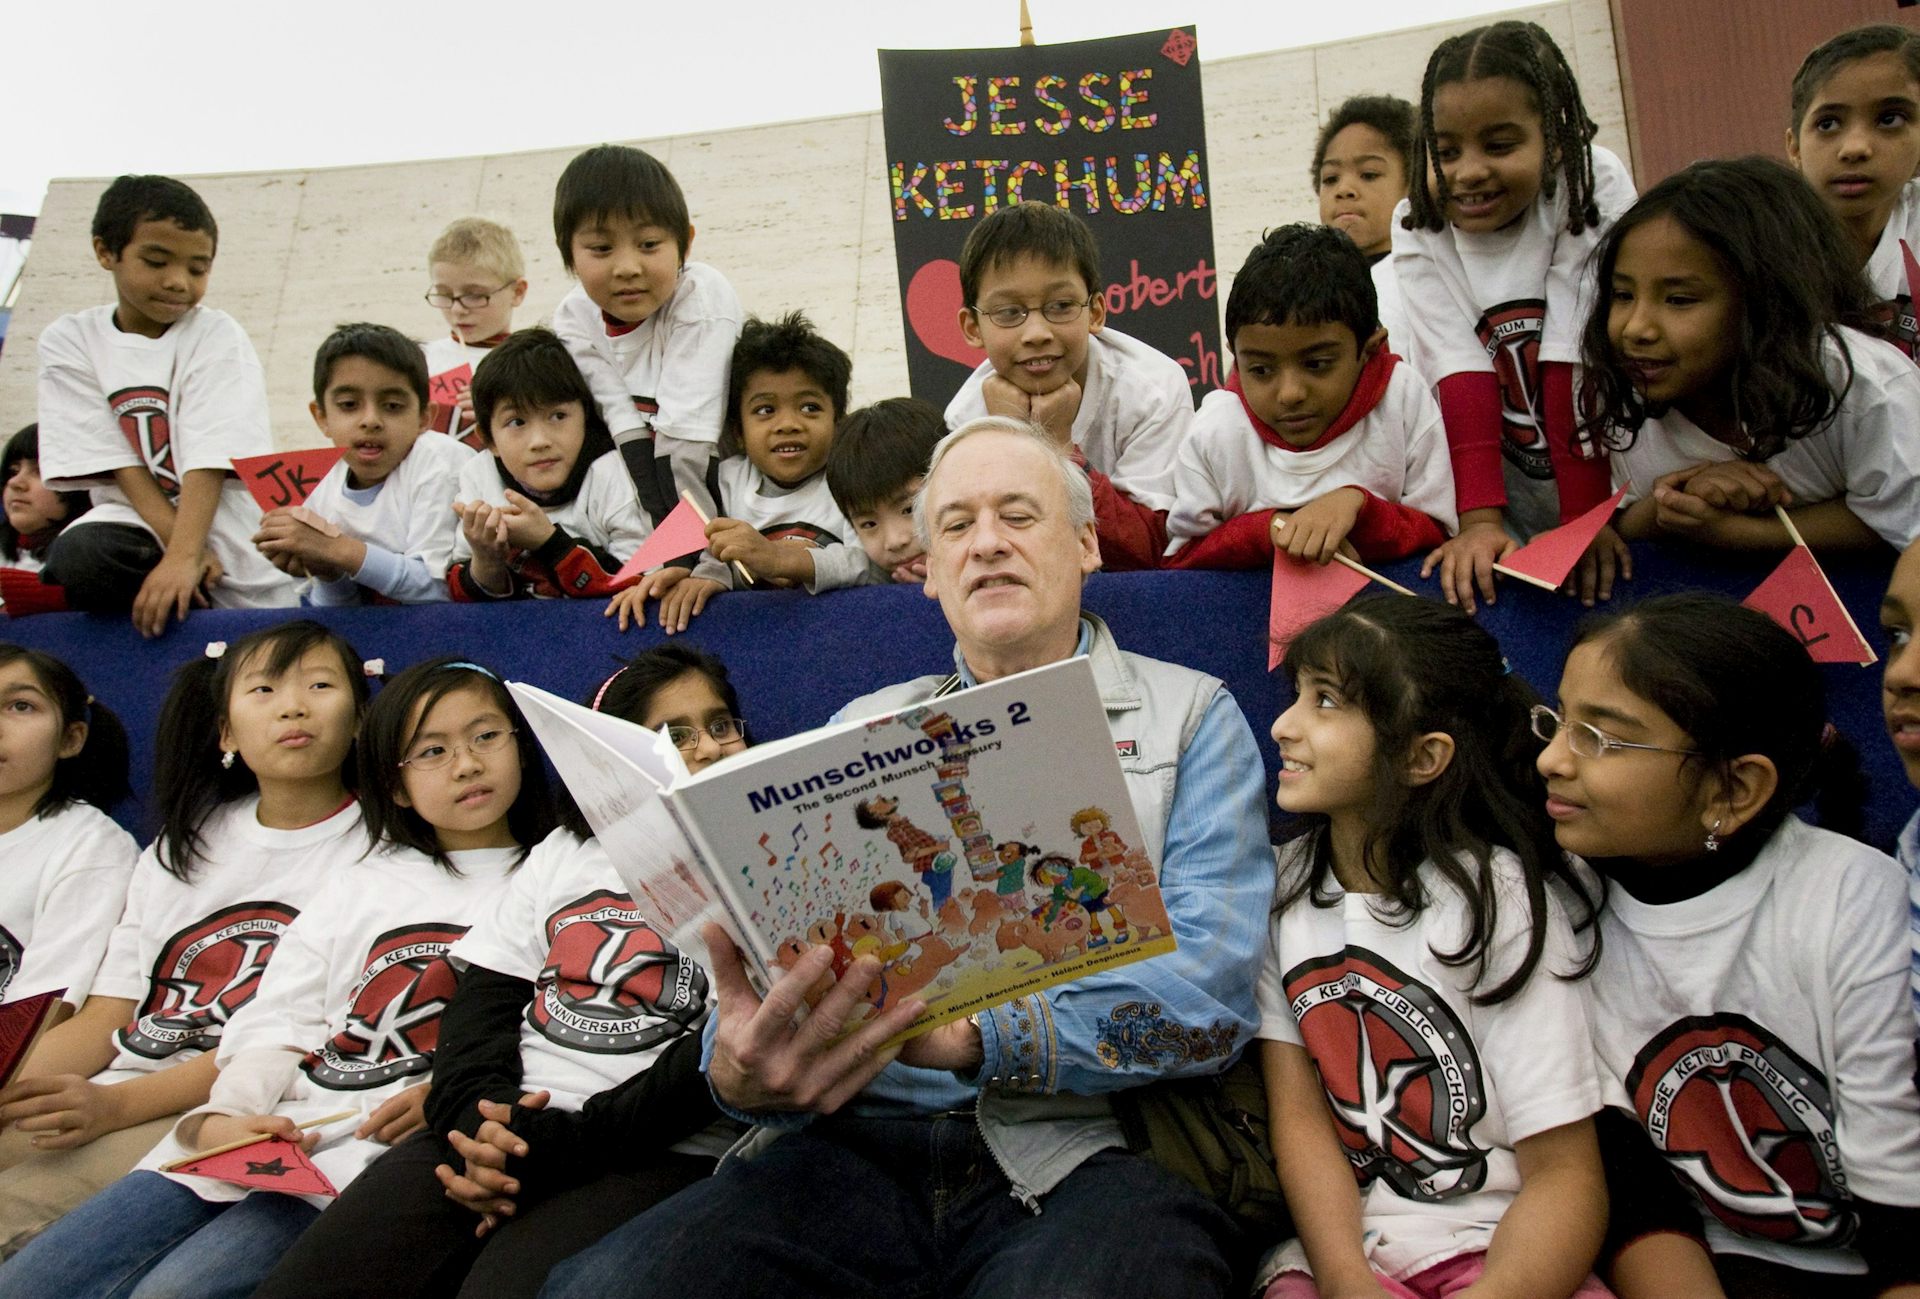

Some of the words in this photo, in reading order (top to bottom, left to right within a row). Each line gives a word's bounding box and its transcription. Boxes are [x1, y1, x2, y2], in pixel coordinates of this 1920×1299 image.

[943, 68, 1158, 136] JESSE
[890, 150, 1207, 221] KETCHUM
[1105, 259, 1216, 314] obert
[256, 460, 320, 507] JK
[747, 717, 996, 814] Munschworks
[1007, 701, 1031, 727] 2
[793, 799, 819, 815] The
[823, 779, 877, 804] Second
[881, 760, 936, 785] Munsch
[939, 739, 1002, 764] Treasury
[177, 940, 207, 974] JESSE
[215, 920, 278, 940] KETCHUM
[384, 944, 449, 964] KETCHU
[548, 1001, 641, 1033] ANNIVERSARY
[948, 996, 984, 1015] Michael
[986, 976, 1041, 1001] Martchenko
[1373, 987, 1435, 1039] PUBLIC
[1651, 1082, 1675, 1141] JESSE
[1740, 1048, 1811, 1114] PUBLIC
